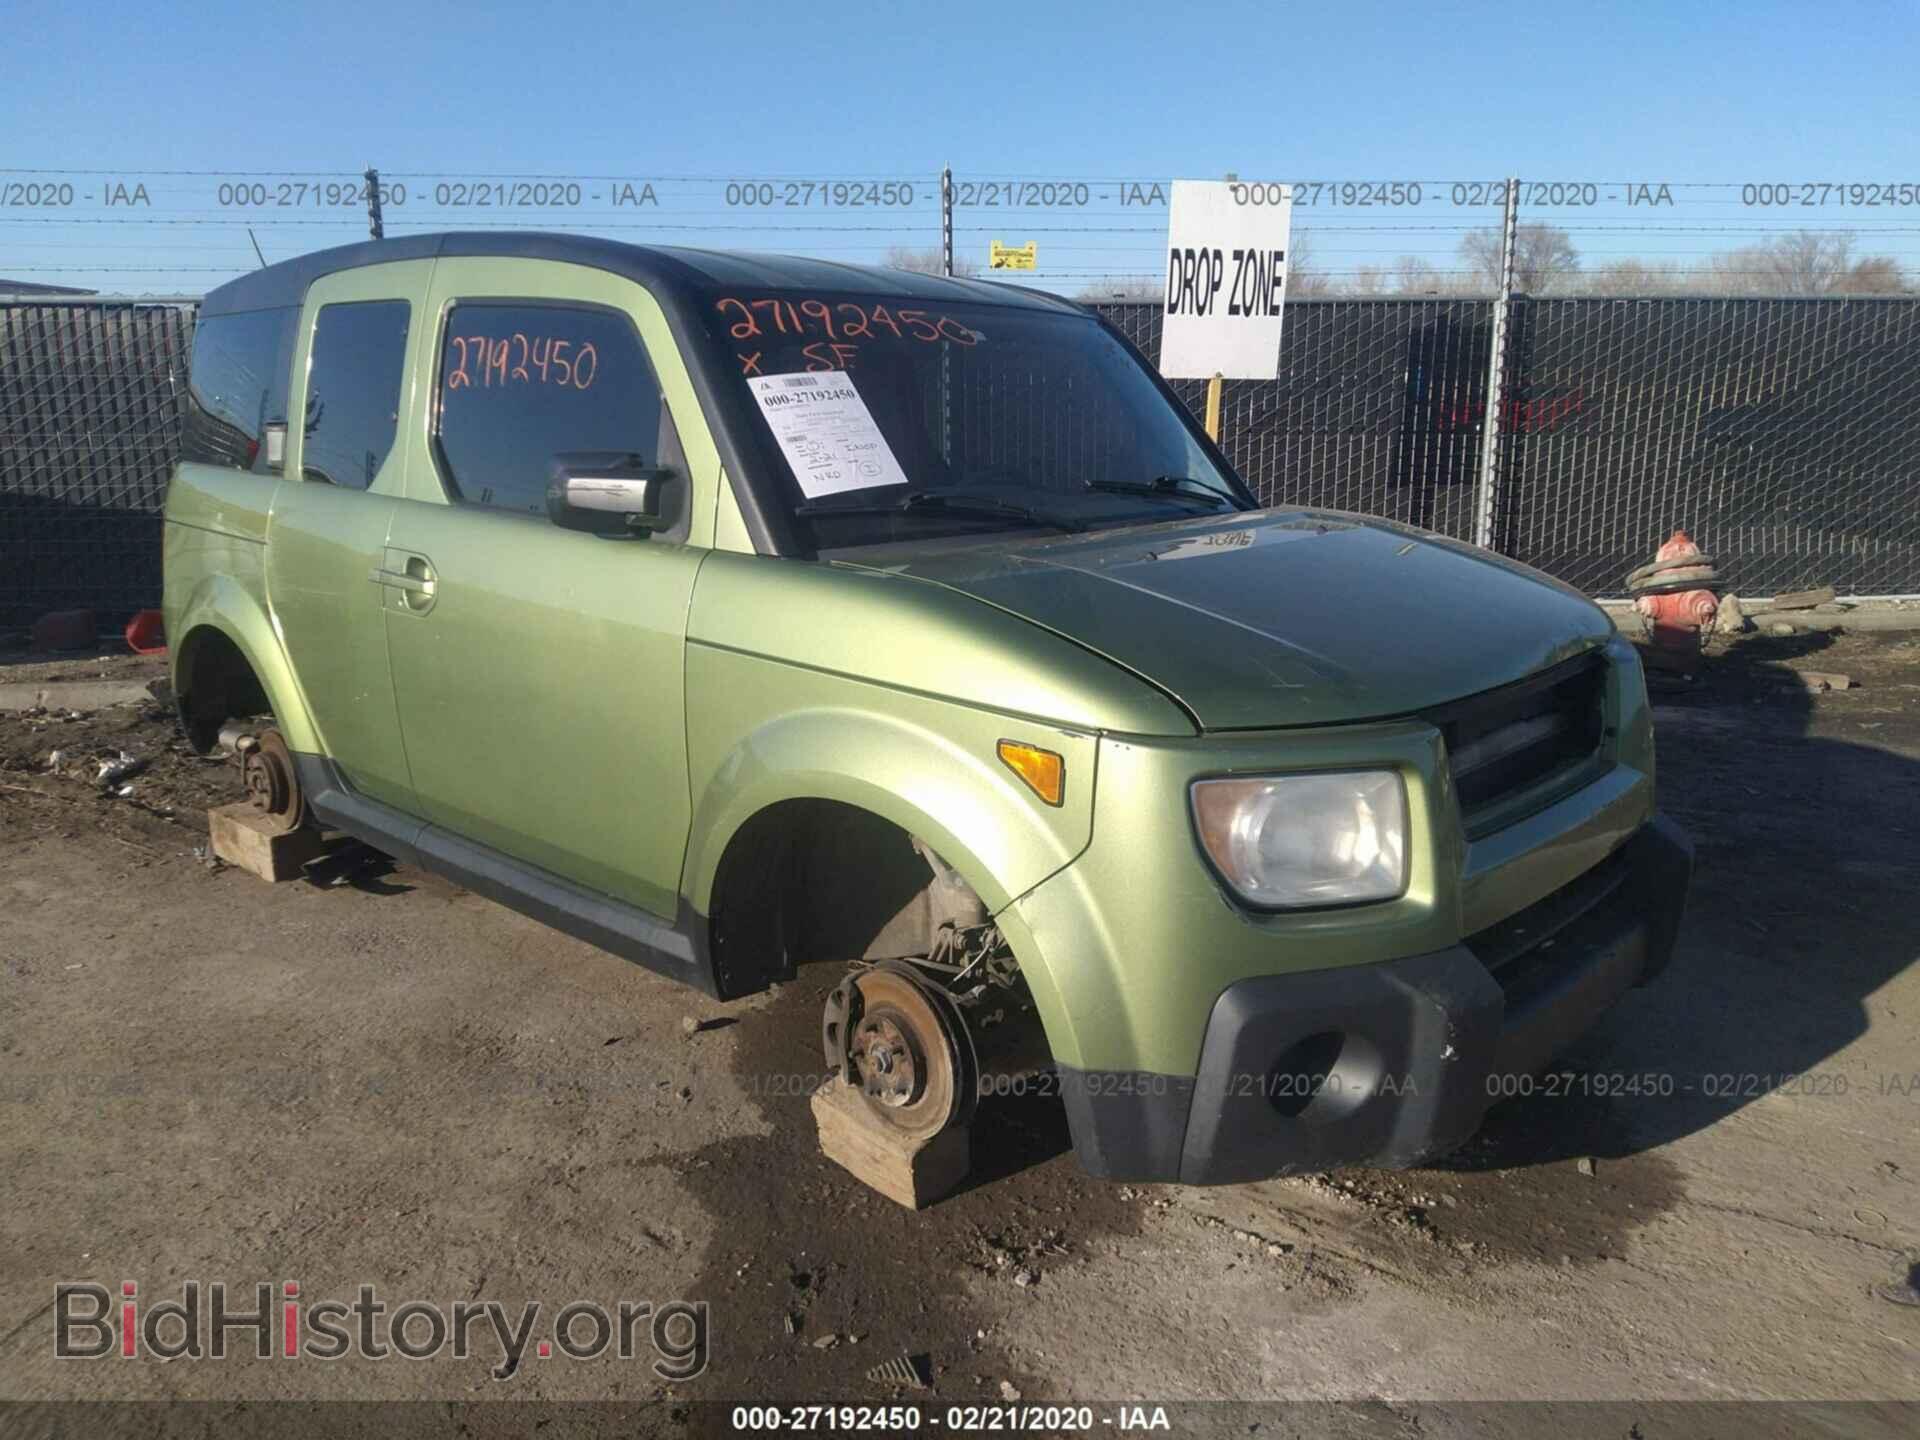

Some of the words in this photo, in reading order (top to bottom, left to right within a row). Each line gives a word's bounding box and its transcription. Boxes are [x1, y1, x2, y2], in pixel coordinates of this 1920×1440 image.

[1167, 247, 1223, 316] DROP
[1228, 248, 1284, 317] ZONE
[717, 298, 979, 344] 27192450
[448, 333, 598, 390] 27192450
[763, 388, 855, 407] 000-27192450
